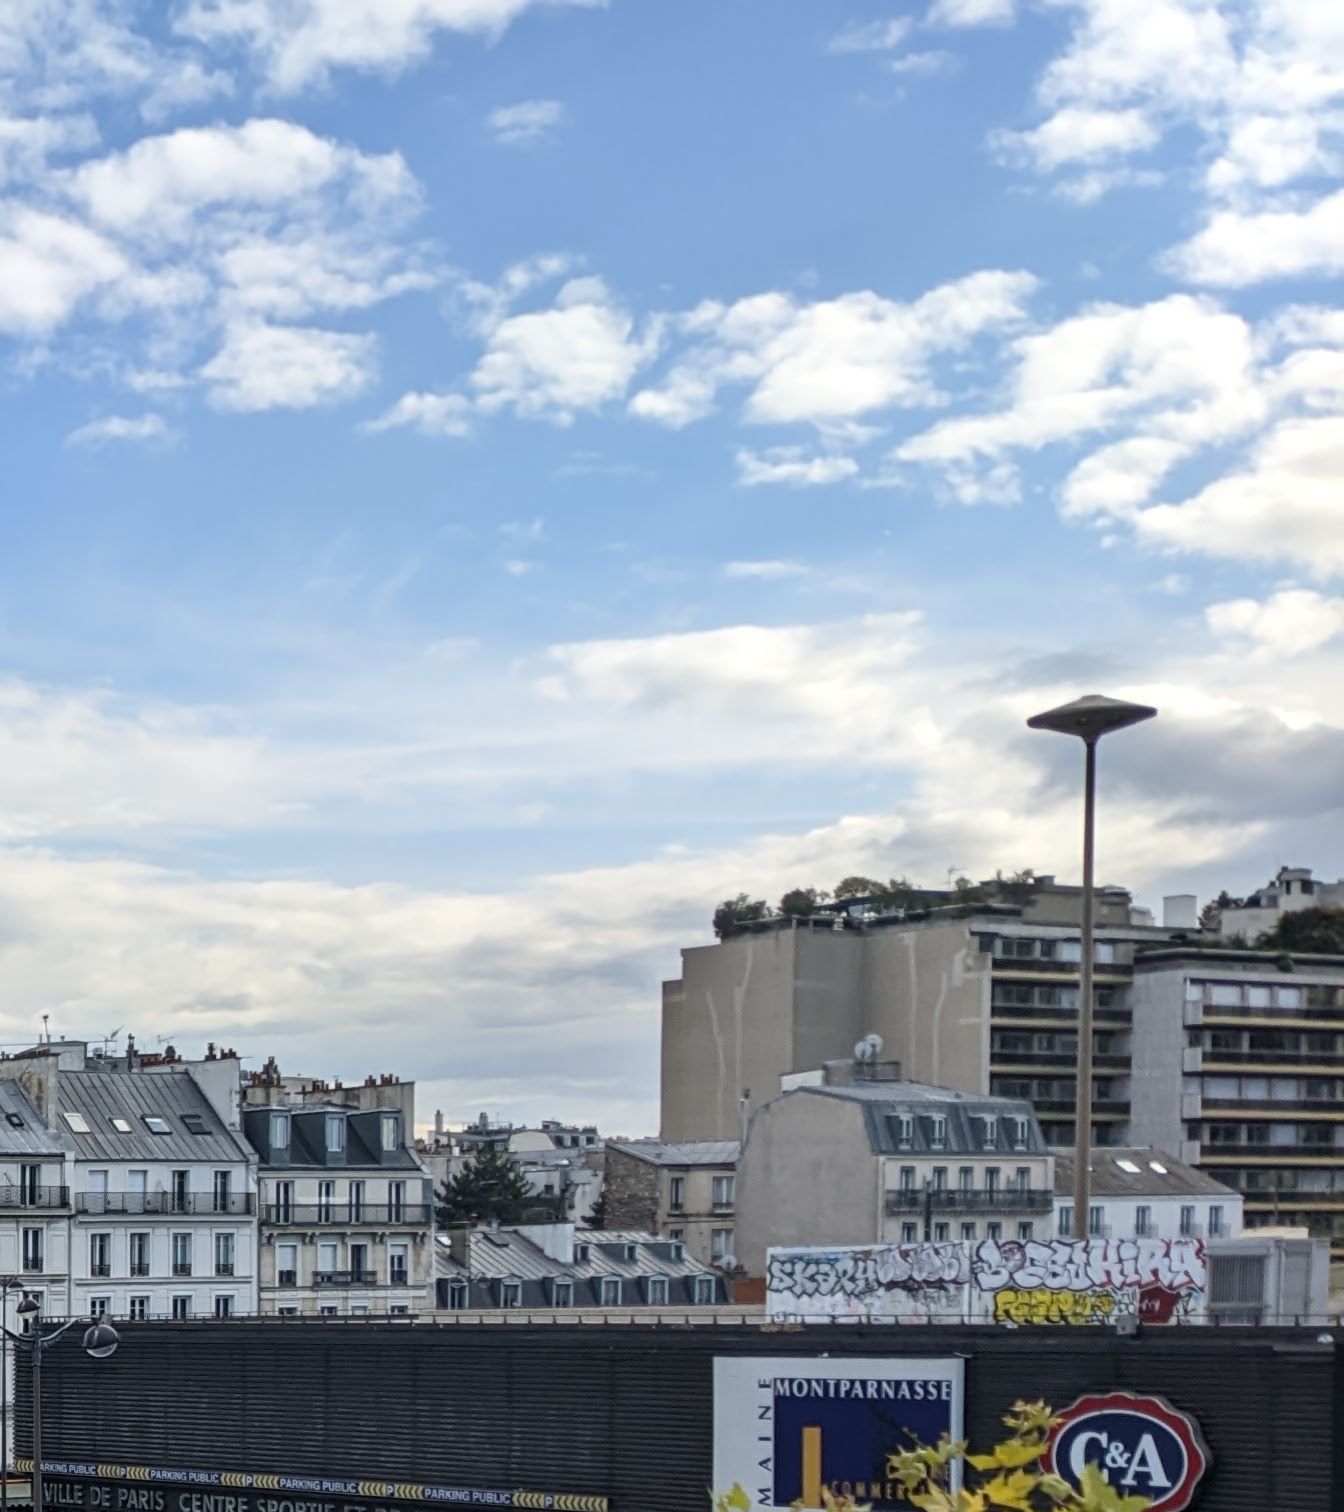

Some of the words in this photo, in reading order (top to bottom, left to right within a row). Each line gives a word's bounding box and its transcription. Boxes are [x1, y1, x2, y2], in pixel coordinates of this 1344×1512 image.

[774, 1378, 952, 1401] MONTPARNASSE
[757, 1378, 773, 1507] MAINE
[1069, 1430, 1173, 1488] C&A
[39, 1463, 68, 1474] ARKING
[68, 1465, 97, 1476] PUBLIC
[150, 1470, 188, 1482] PARKING
[189, 1472, 219, 1483] PUBLIC
[279, 1478, 321, 1491] PARKING
[322, 1481, 357, 1493] PUBLIC
[43, 1482, 83, 1504] VILLE
[90, 1486, 111, 1507] DE
[118, 1488, 165, 1512] PARIS
[424, 1488, 471, 1502] PARKING
[472, 1491, 511, 1505] PUBLIC
